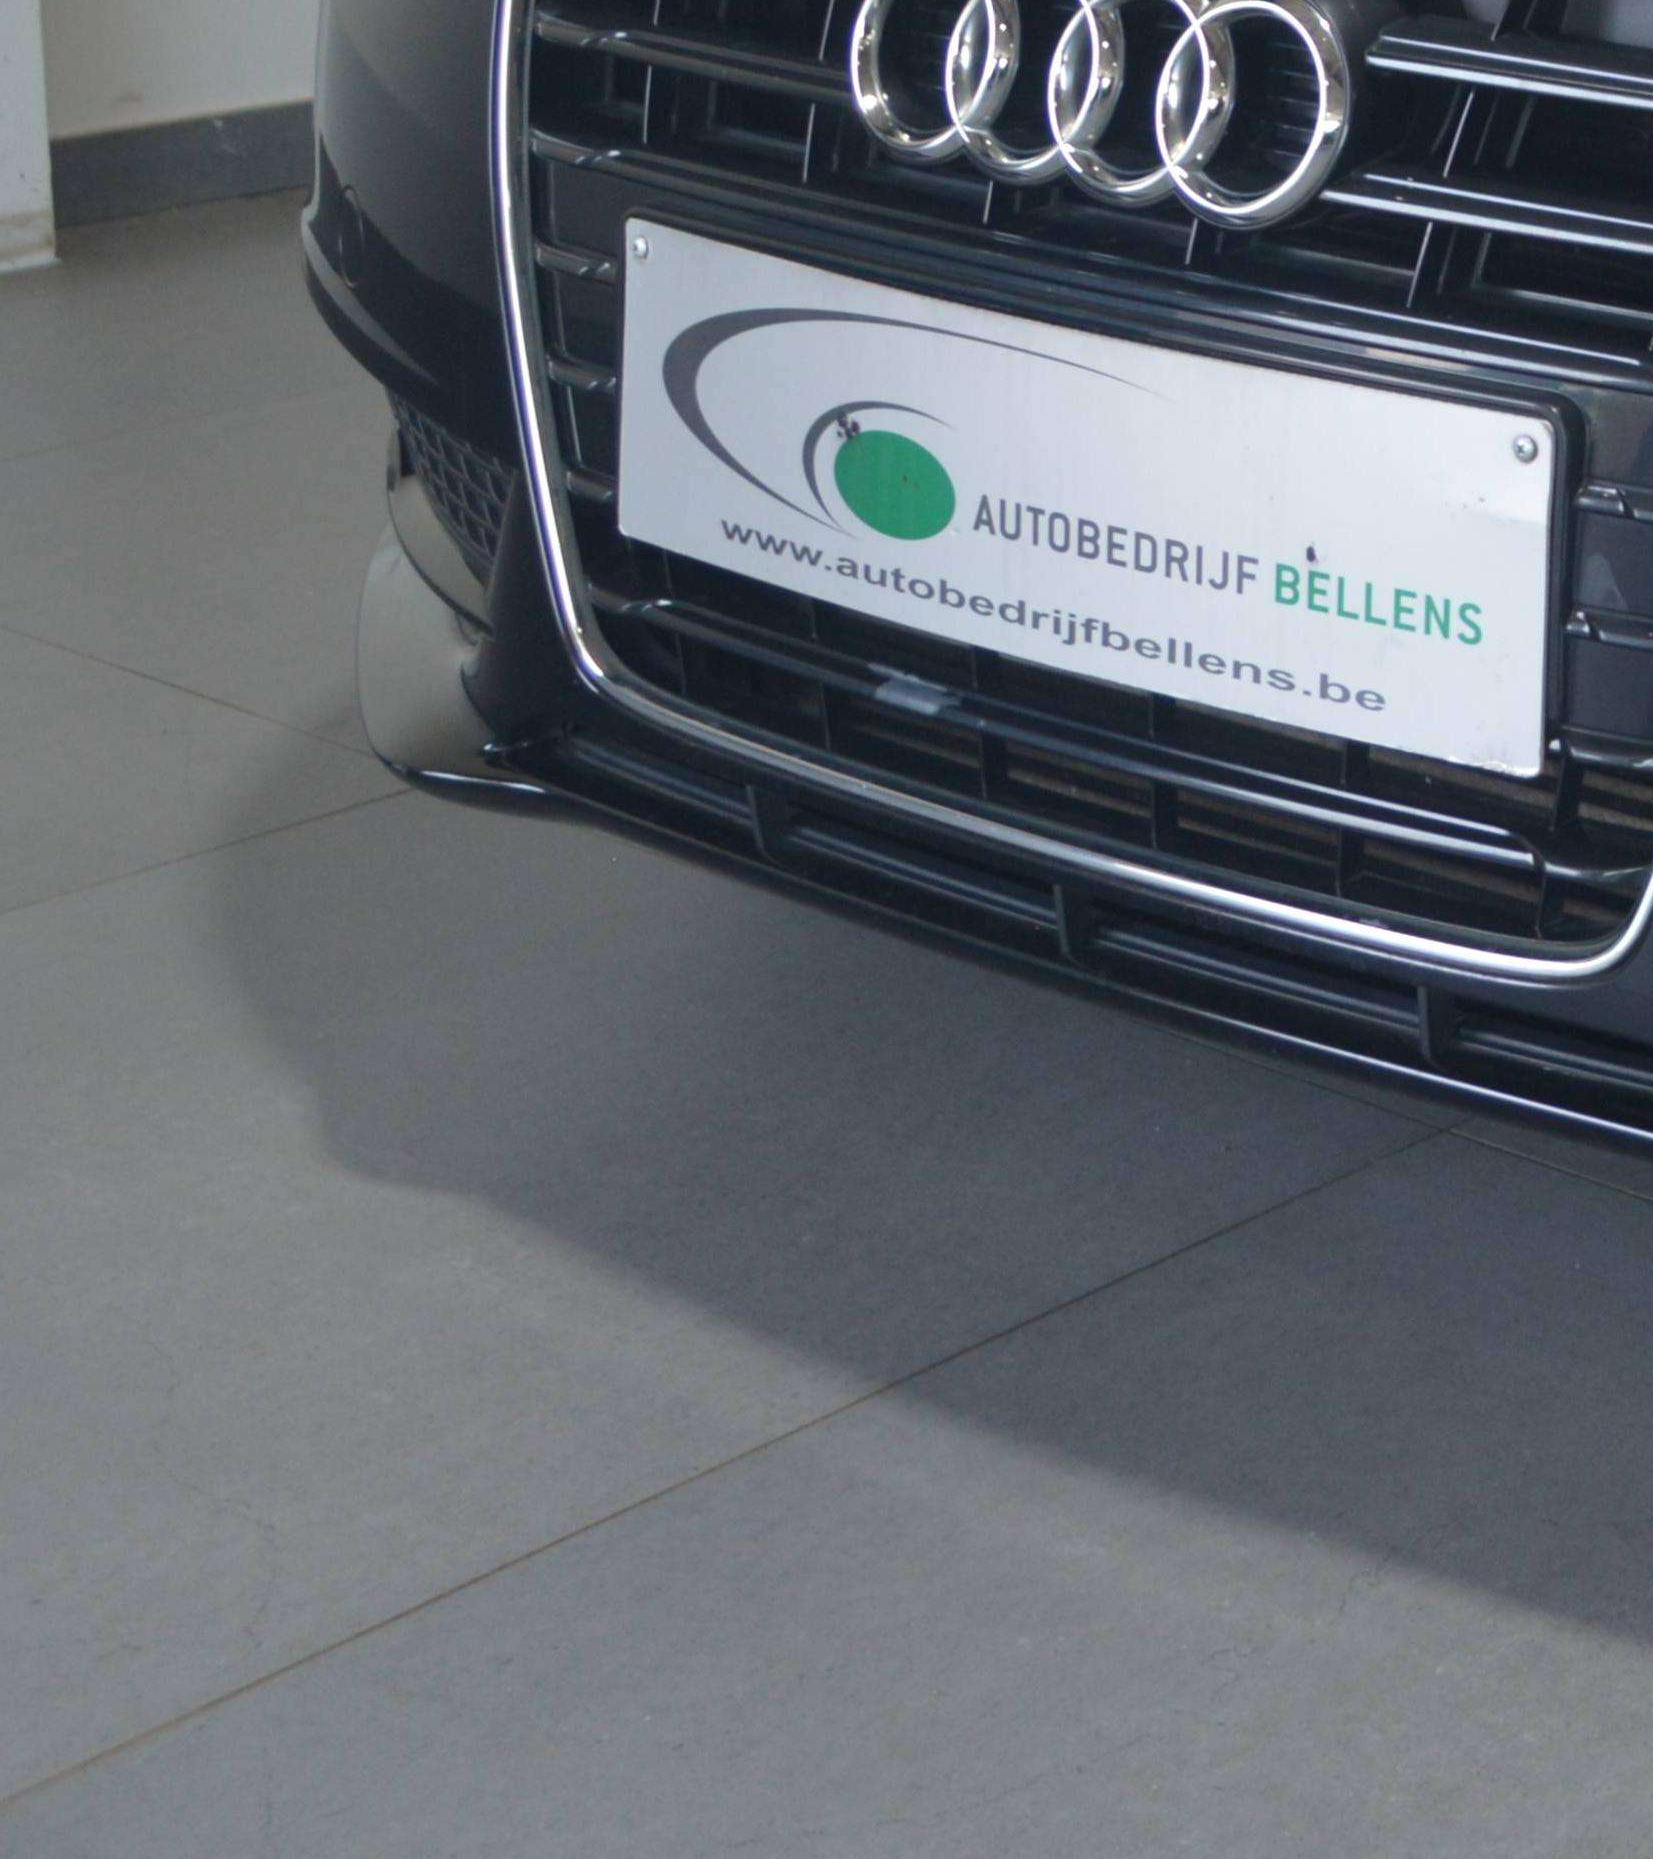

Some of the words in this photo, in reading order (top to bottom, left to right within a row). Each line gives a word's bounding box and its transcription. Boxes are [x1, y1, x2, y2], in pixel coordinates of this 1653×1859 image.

[720, 518, 1387, 712] www.autobedrijfbellens.be
[973, 494, 1260, 595] AUTOBEDRIJF
[1274, 562, 1483, 646] BELLENS
